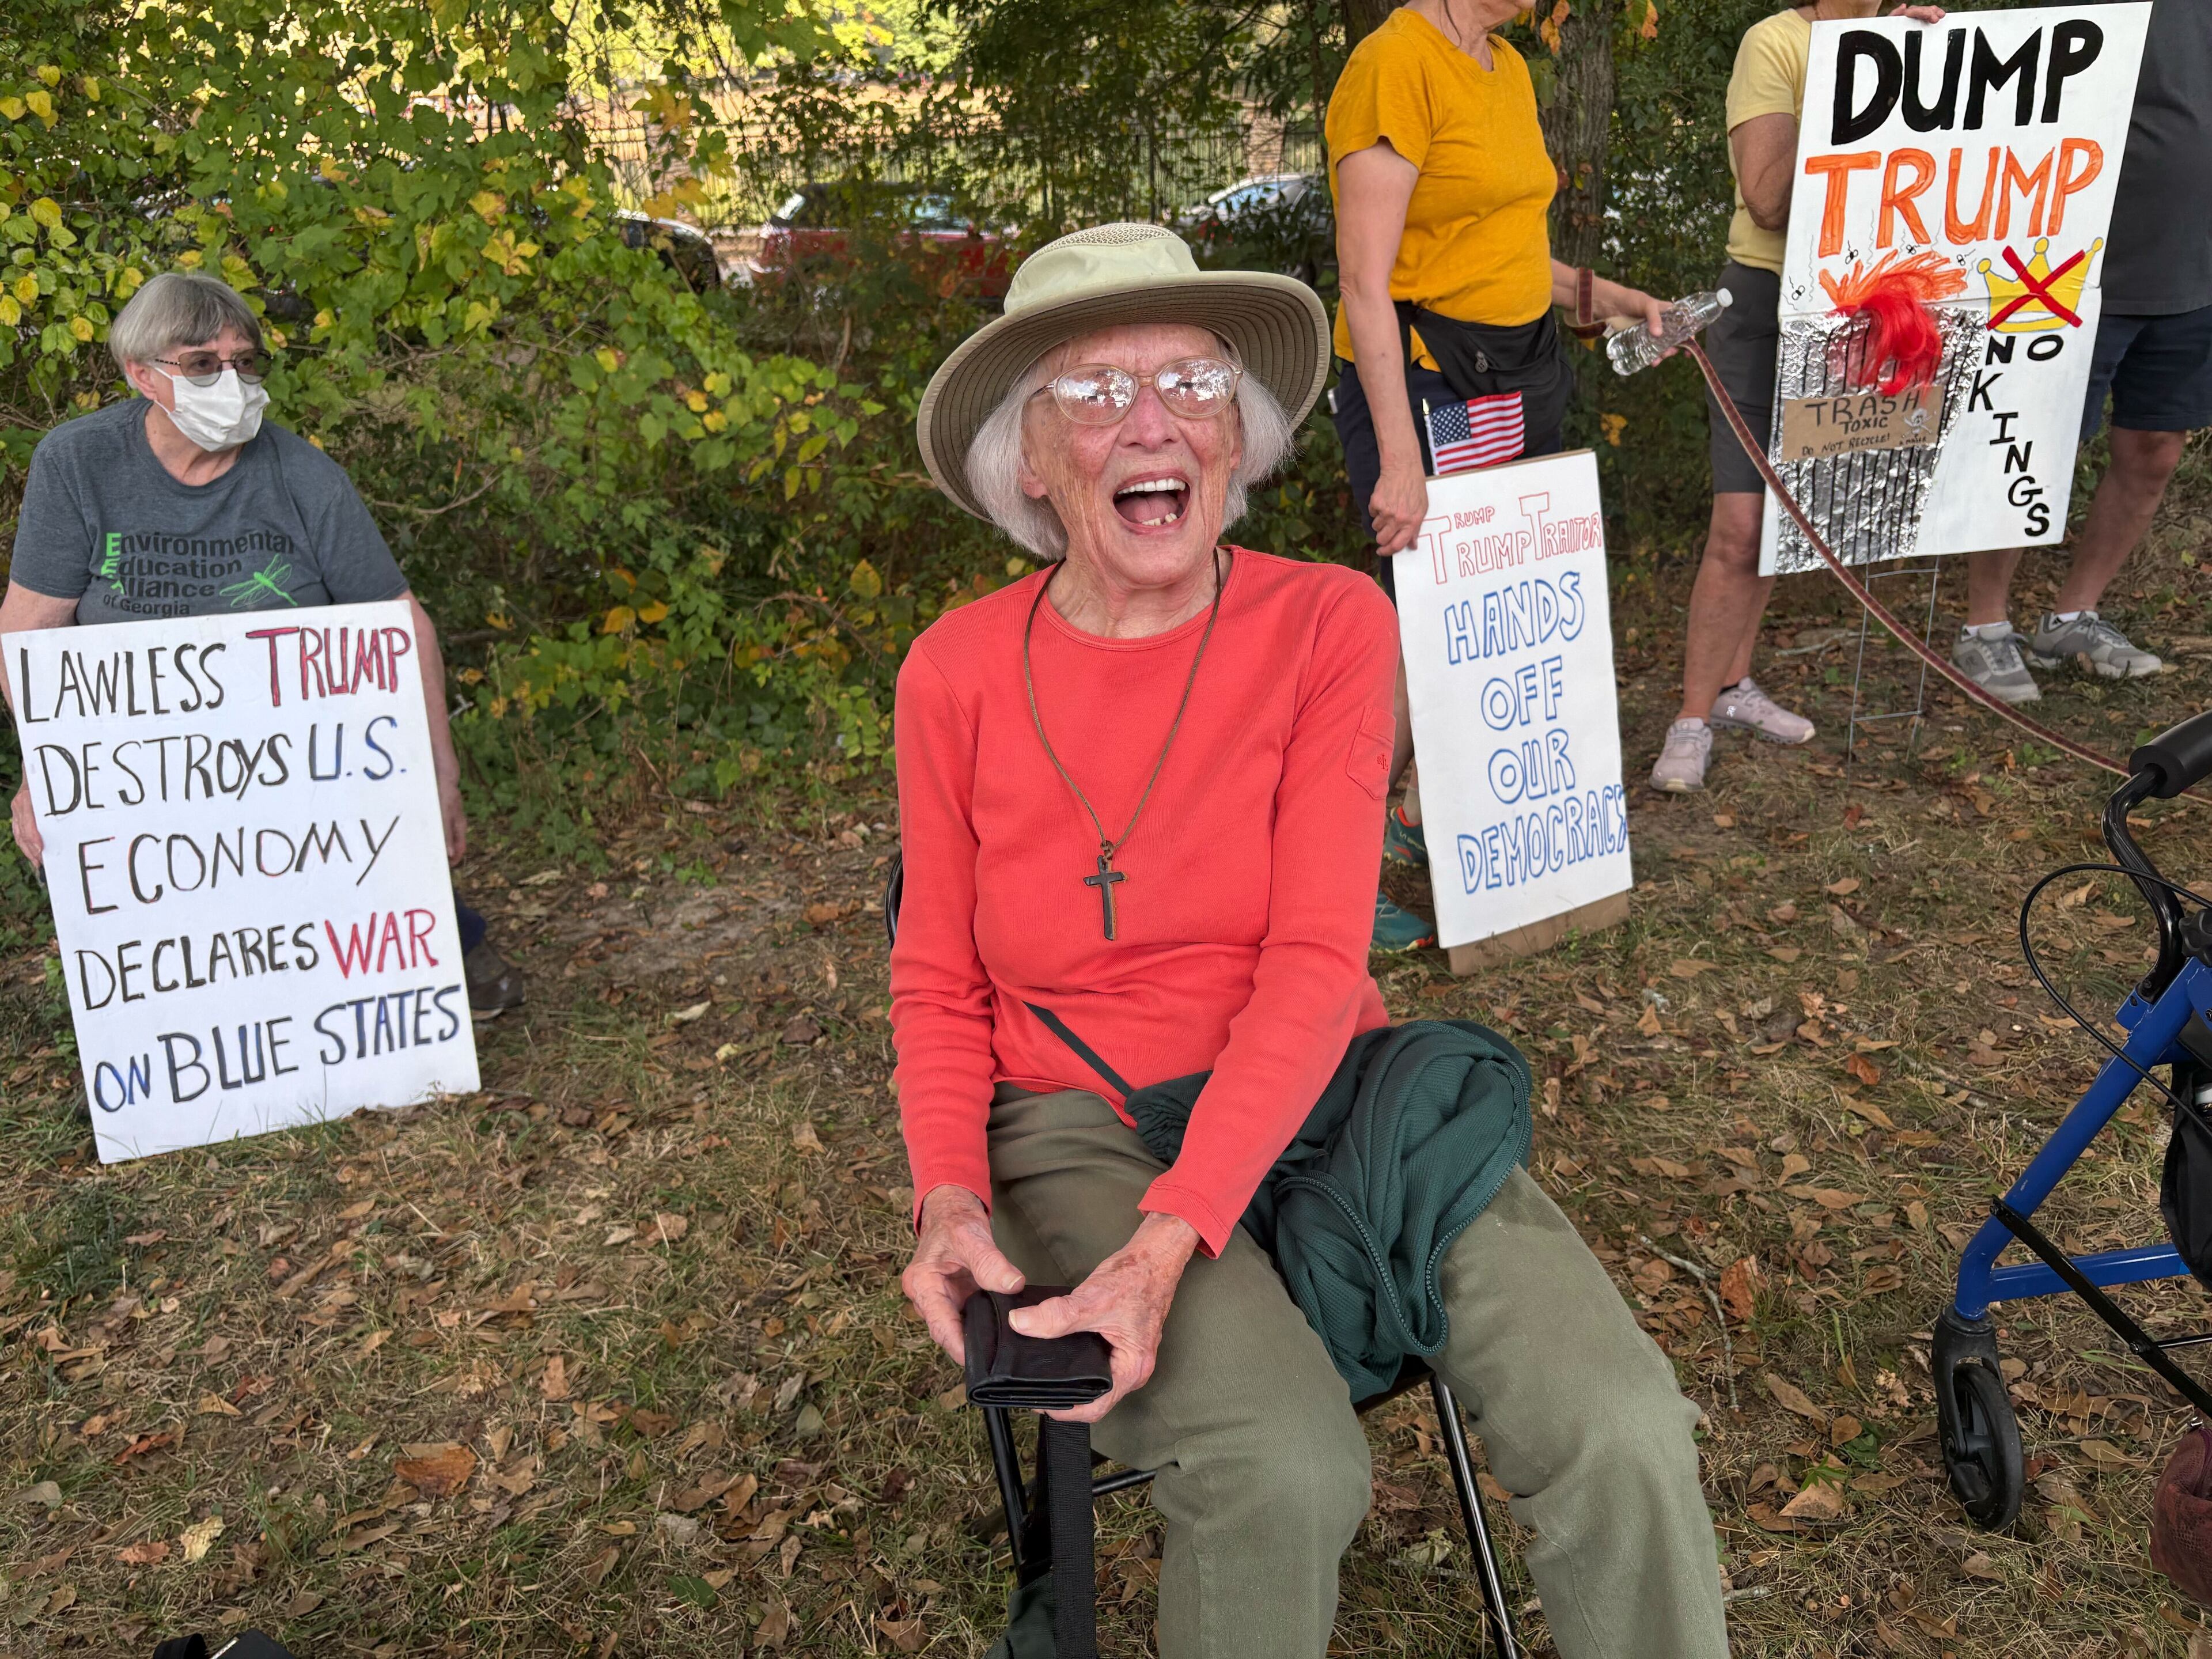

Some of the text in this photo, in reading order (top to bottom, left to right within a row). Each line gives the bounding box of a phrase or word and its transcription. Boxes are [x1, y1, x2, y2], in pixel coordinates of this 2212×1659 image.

[1831, 19, 2104, 145] DUMP
[1804, 138, 2104, 258] TRUMP
[1802, 446, 1813, 456] DO
[1821, 441, 1844, 453] NOT
[1849, 433, 1890, 449] RECYCLE!
[1805, 390, 1919, 427] TRASH
[1839, 416, 1889, 435] TOXIC
[100, 556, 243, 579] Education
[106, 530, 294, 557] Environmental
[1418, 491, 1603, 585] TRUMP TRAITOR
[120, 601, 191, 618] Georgia
[1444, 571, 1585, 665] HANDS
[20, 626, 411, 724] LAWLESS TRUMP
[1481, 655, 1563, 731] OFF
[34, 715, 408, 817] DESTROYS U.S.
[1487, 728, 1576, 805] OUR
[78, 816, 400, 915] ECONOMY
[75, 908, 439, 1011] DECLARES WAR
[93, 984, 462, 1113] ON BLUE STATES
